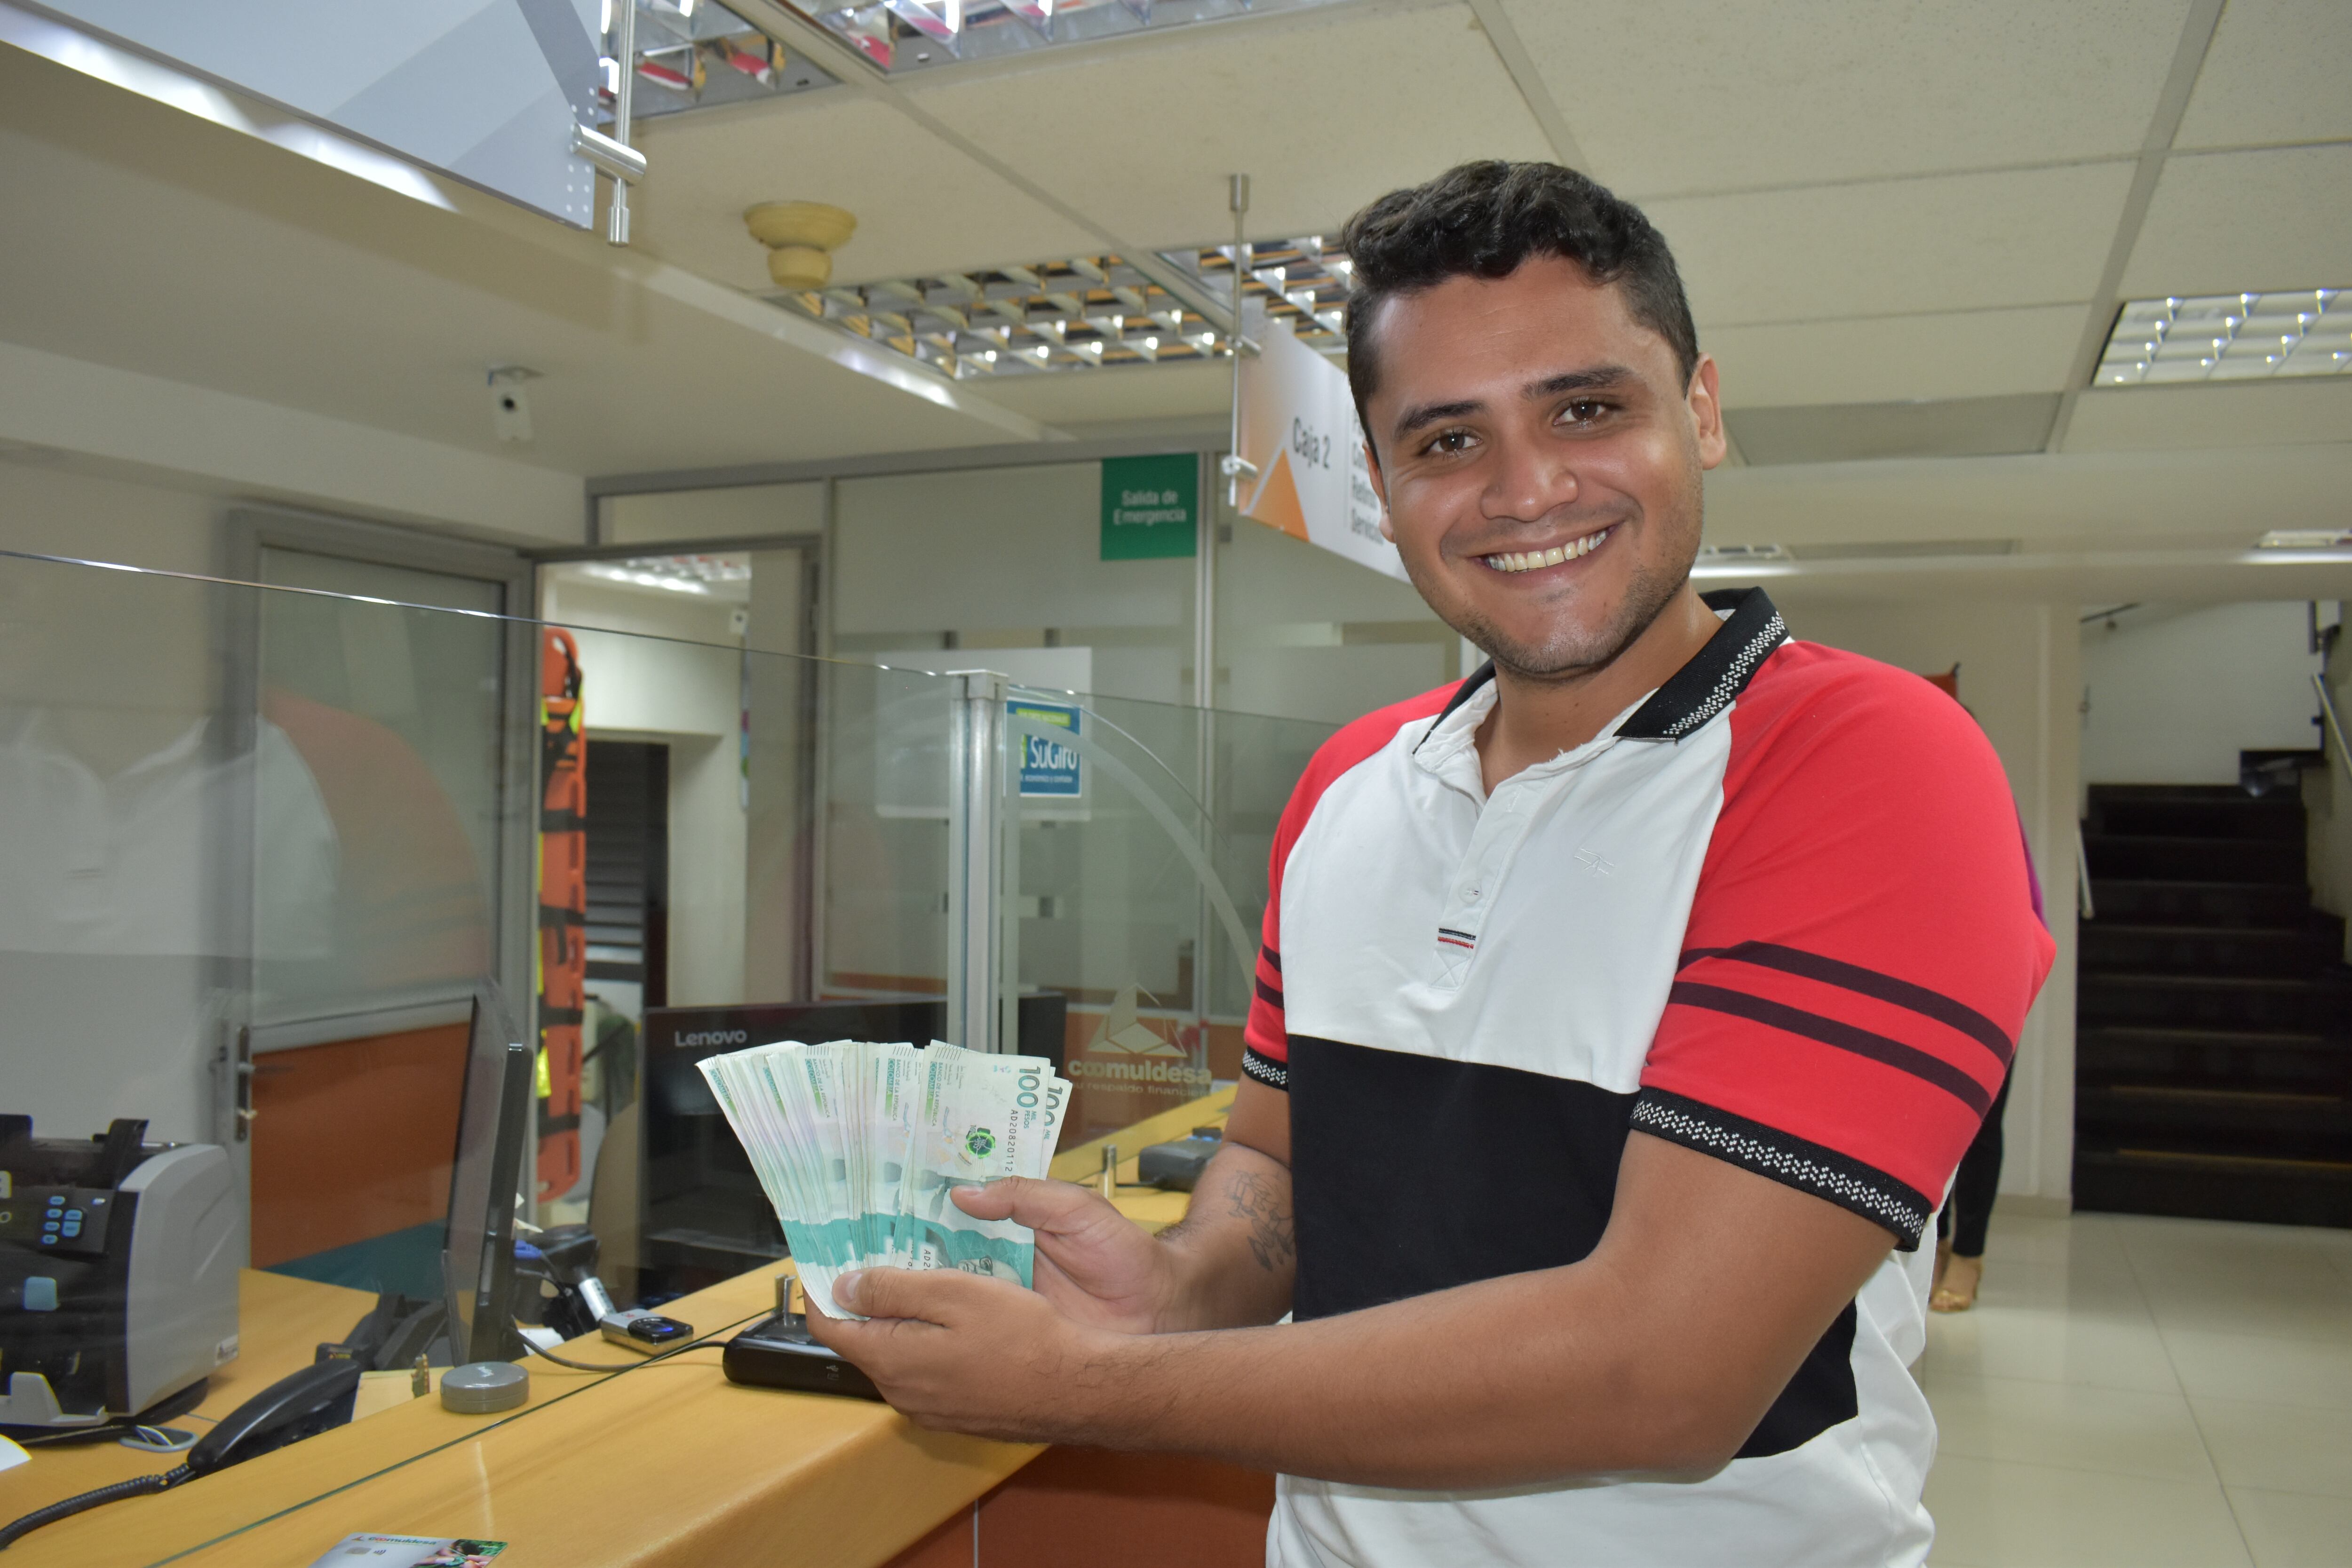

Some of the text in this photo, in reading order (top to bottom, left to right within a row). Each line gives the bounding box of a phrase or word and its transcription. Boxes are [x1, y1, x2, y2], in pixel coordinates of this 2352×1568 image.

[1293, 417, 1319, 469] Caja
[1323, 435, 1331, 470] 2
[1121, 489, 1178, 506] Salida de
[1113, 508, 1186, 526] Emergencia
[1030, 736, 1077, 770] SuGiro
[675, 1030, 747, 1047] Lenovo
[805, 1059, 820, 1093] COLOMBIA
[812, 1059, 821, 1076] BANCO
[886, 1059, 895, 1094] COLOMBIA
[927, 1061, 937, 1099] COLOMBIA
[1068, 1059, 1212, 1084] coomuldesa
[1017, 1066, 1041, 1108] 100
[1005, 1109, 1018, 1171] AD20820112
[368, 1536, 438, 1545] coomuldesa
